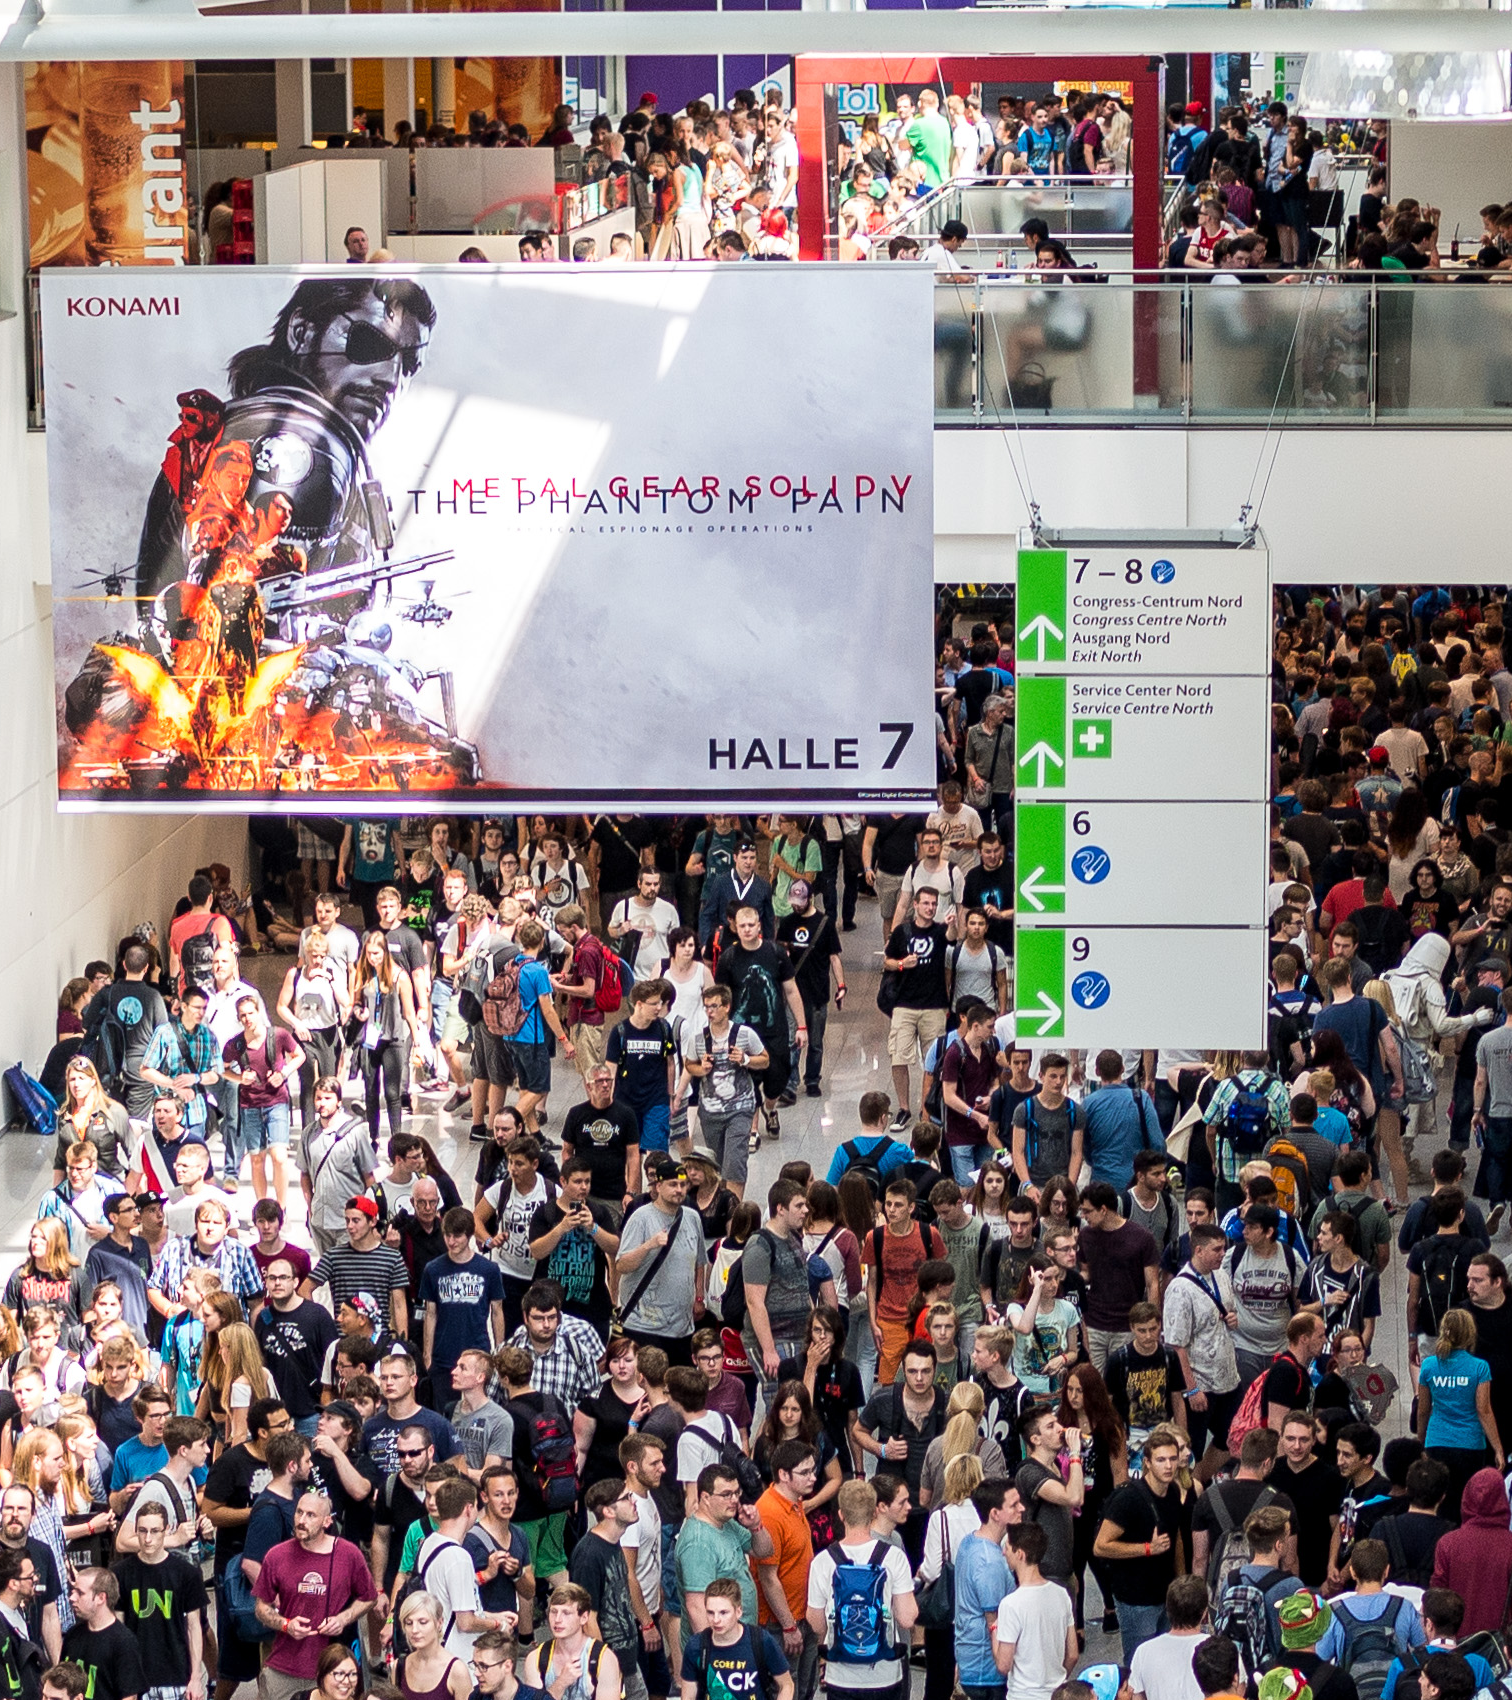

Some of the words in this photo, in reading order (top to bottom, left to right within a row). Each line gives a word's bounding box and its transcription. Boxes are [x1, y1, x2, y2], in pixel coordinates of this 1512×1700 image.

[66, 296, 180, 317] KONAMI
[453, 477, 587, 498] METAL
[608, 476, 720, 499] GEAR
[745, 475, 876, 498] SOLID
[890, 474, 912, 498] V
[407, 490, 487, 514] THE
[518, 489, 754, 514] PHANTOM
[791, 487, 904, 514] PAIN
[599, 525, 694, 534] ESPIONAGE
[707, 524, 814, 533] OPERATIONS
[1072, 558, 1091, 585] 7
[1124, 558, 1144, 585] 8
[1072, 595, 1204, 611] Congress-Centrum
[1207, 595, 1243, 608] Nord
[1072, 614, 1134, 629] Congress
[1136, 614, 1183, 626] Centre
[1185, 613, 1227, 626] North
[1072, 632, 1132, 647] Ausgang
[1135, 632, 1170, 645] Nord
[1072, 651, 1099, 663] Exit
[1100, 650, 1142, 663] North
[1072, 684, 1122, 697] Service
[1125, 684, 1174, 697] Center
[1176, 684, 1211, 697] Nord
[1071, 702, 1121, 715] Service
[1123, 702, 1170, 715] Centre
[1172, 702, 1214, 715] North
[708, 737, 859, 770] HALLE
[879, 722, 915, 770] 7
[1072, 810, 1092, 836] 6
[1071, 936, 1091, 962] 9
[1432, 1375, 1456, 1389] Wii
[713, 1660, 733, 1670] CORE
